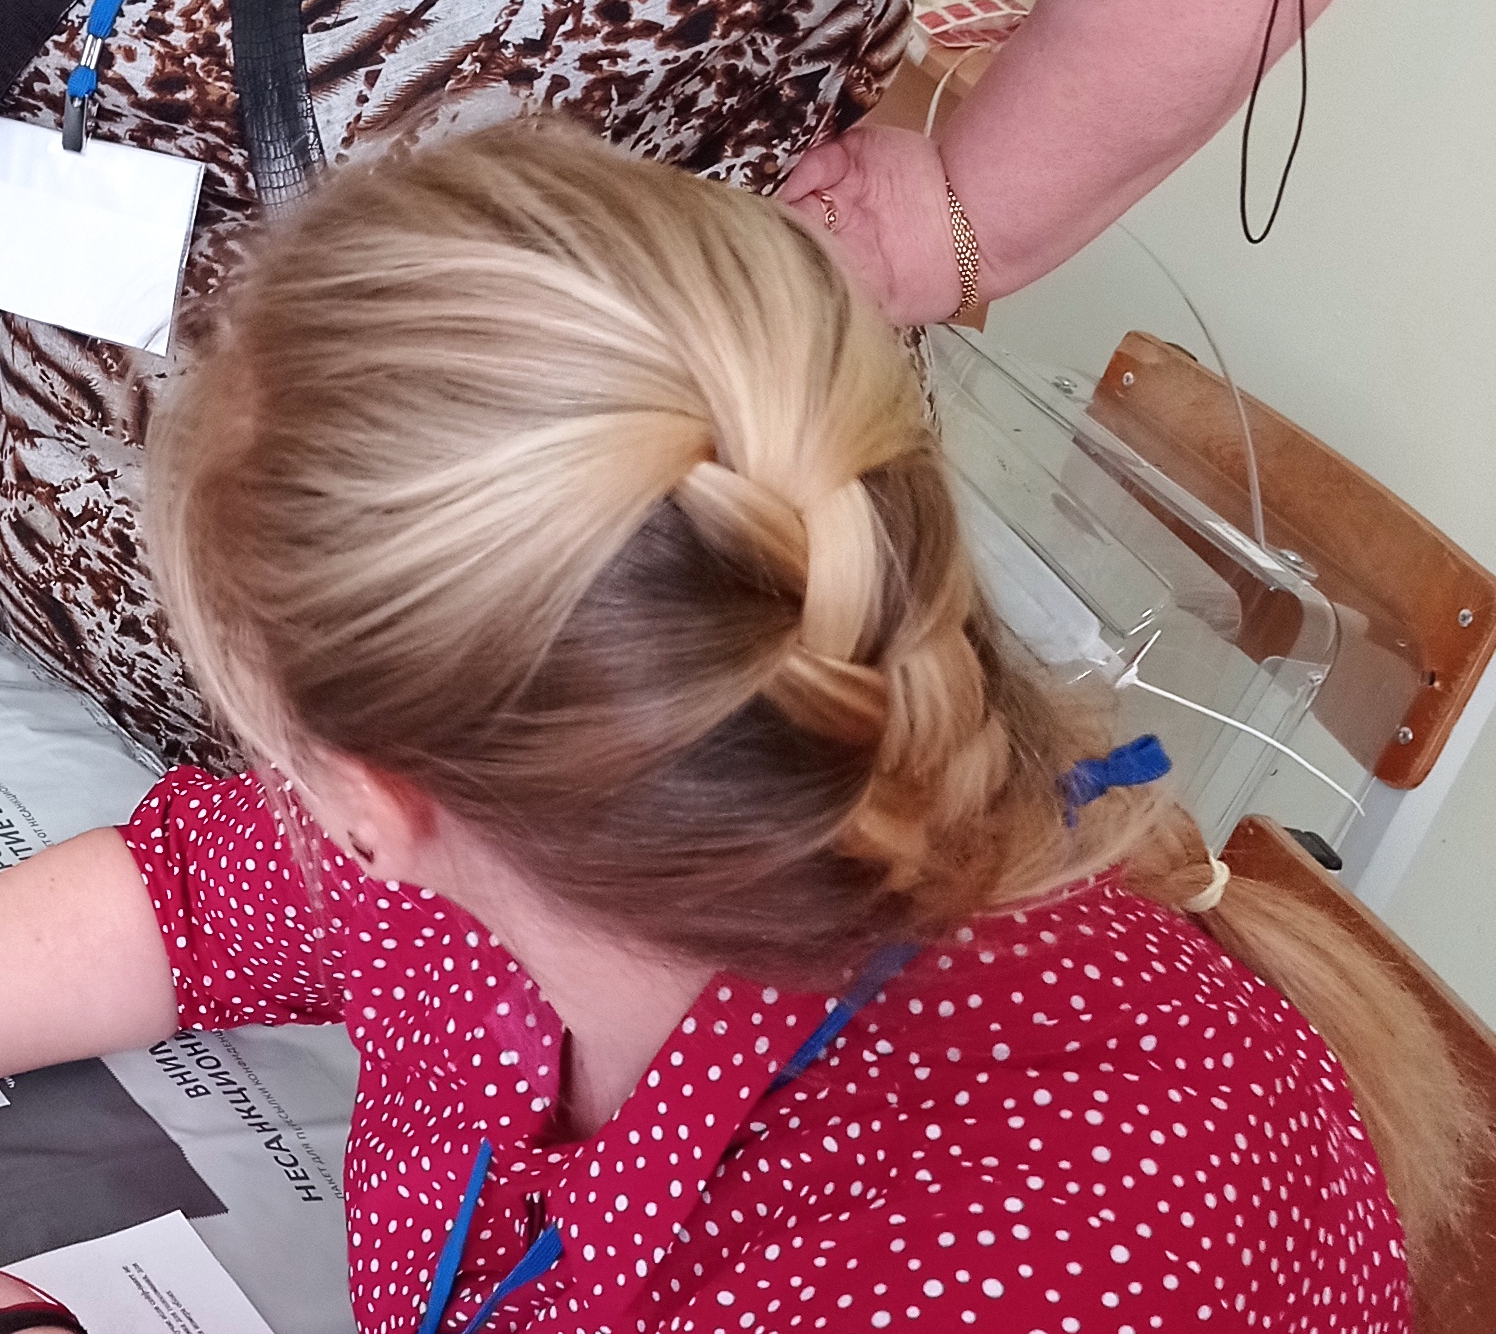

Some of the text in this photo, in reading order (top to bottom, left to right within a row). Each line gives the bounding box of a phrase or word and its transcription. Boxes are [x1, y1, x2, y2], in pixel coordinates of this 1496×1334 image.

[33, 828, 47, 839] ОТ
[258, 1087, 307, 1139] ПЕРЕСЫЛКИ
[304, 1142, 325, 1166] ДЛЯ
[319, 1166, 346, 1199] ПАКЕТ
